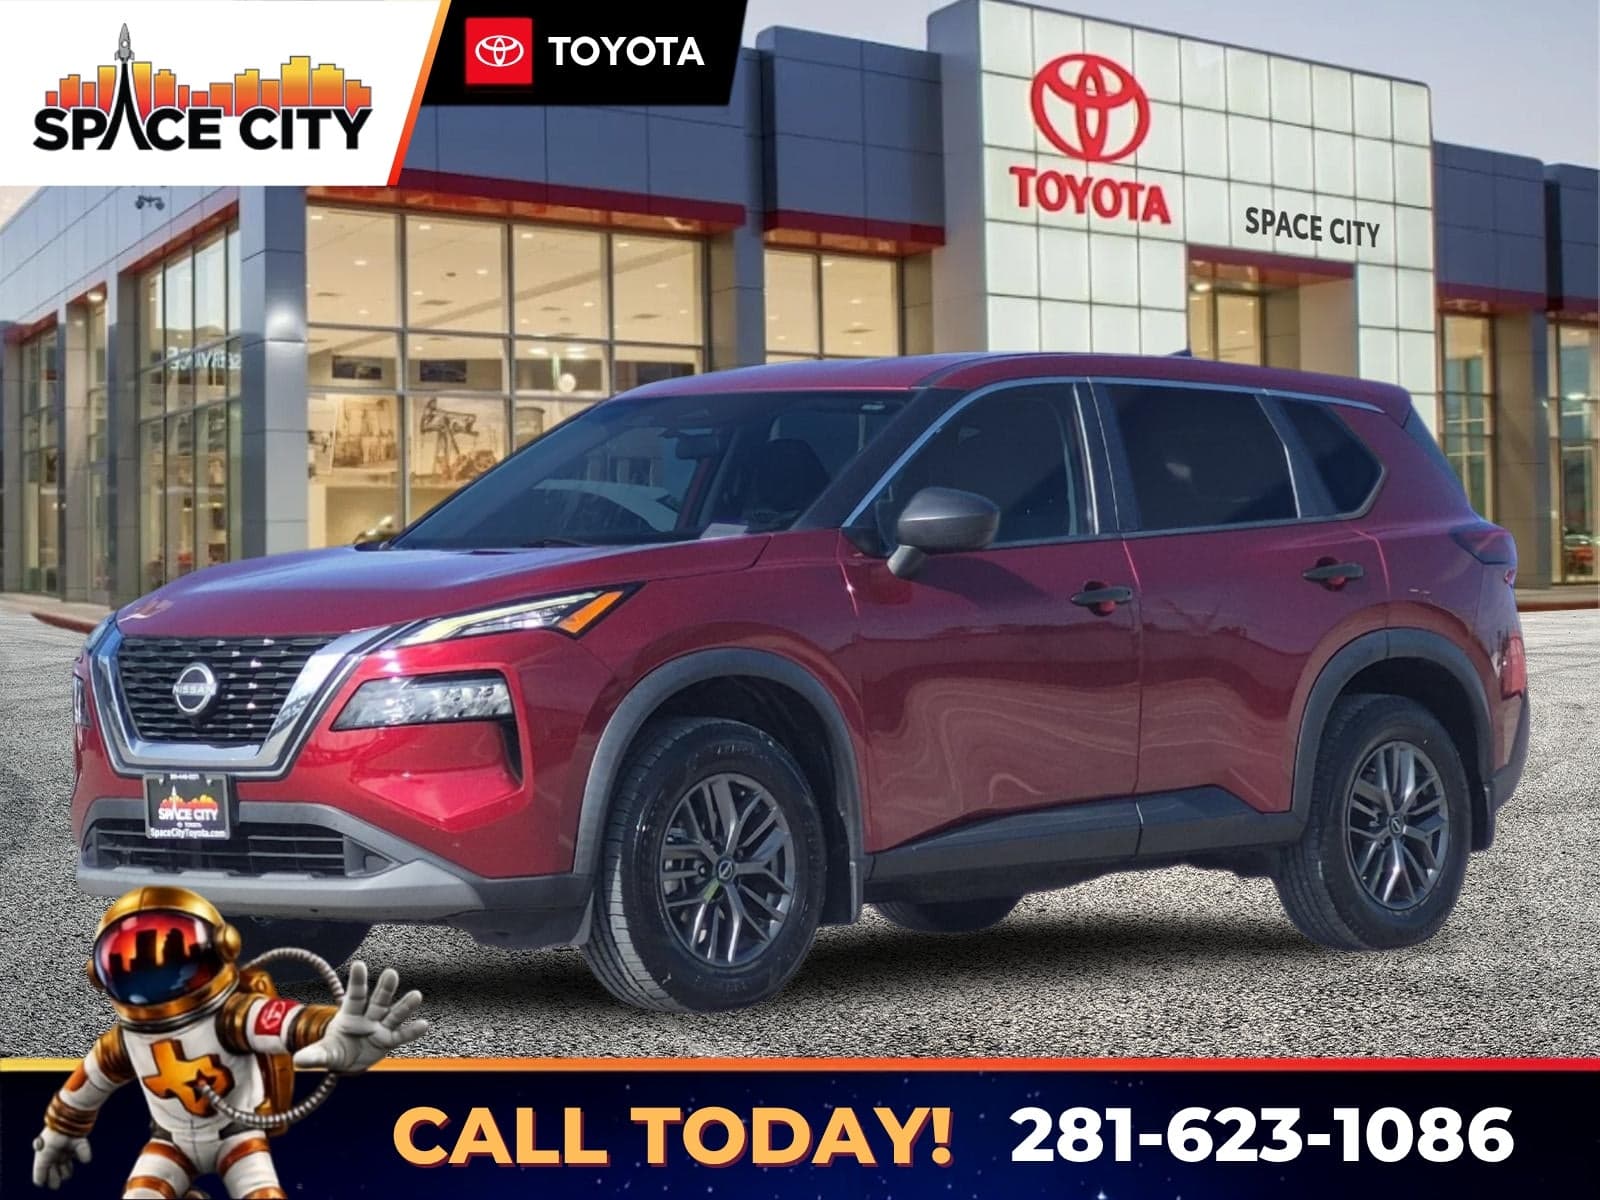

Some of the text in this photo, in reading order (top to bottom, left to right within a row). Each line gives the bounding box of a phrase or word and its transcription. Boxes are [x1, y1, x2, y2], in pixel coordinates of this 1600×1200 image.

[1009, 165, 1172, 225] TOYOTA
[1245, 207, 1381, 248] SPACE CITY
[172, 683, 217, 696] NISSAN
[158, 807, 218, 821] SPACE CITY
[150, 827, 226, 838] SpaceCityToyota.com
